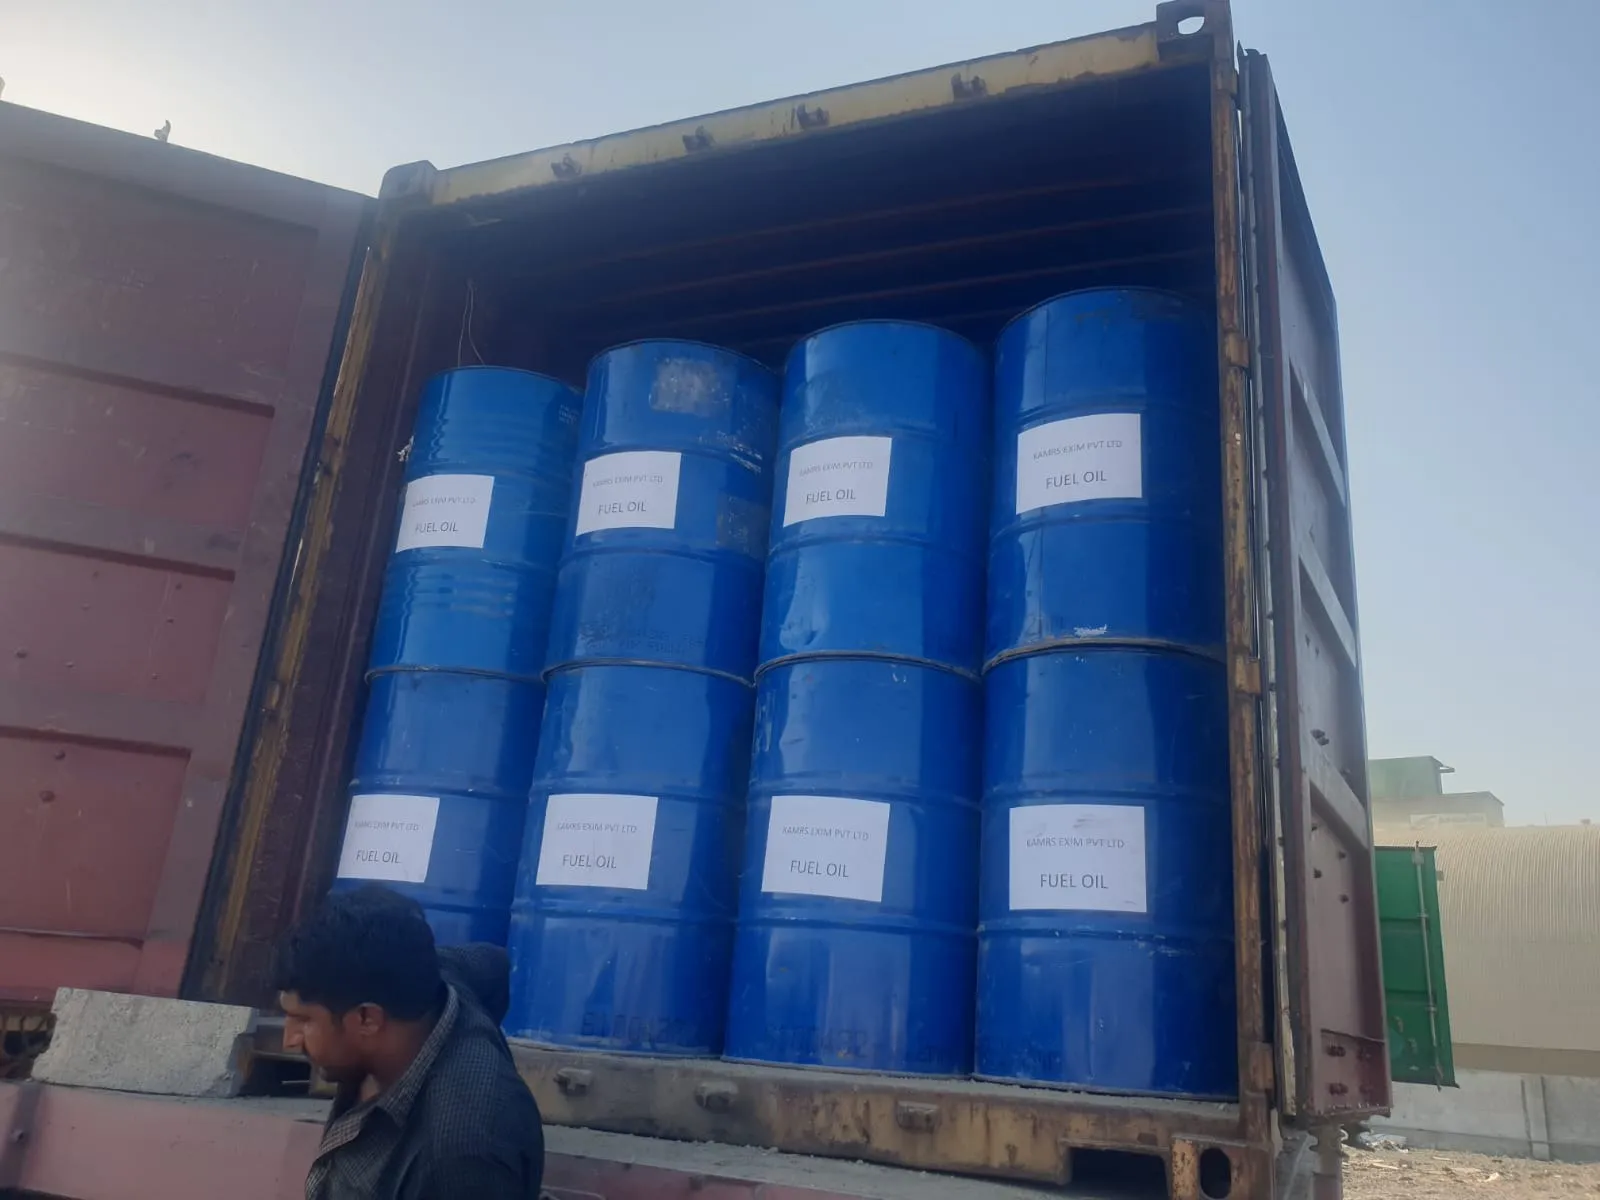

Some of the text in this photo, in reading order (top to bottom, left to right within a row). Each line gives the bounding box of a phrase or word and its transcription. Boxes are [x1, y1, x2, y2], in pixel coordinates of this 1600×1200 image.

[1063, 442, 1086, 455] EXIM
[1087, 440, 1105, 450] PVT
[1107, 440, 1123, 448] LTD
[842, 460, 858, 470] PVT
[859, 461, 873, 470] LTD
[1046, 470, 1108, 489] FUEL OIL
[806, 488, 856, 504] FUEL OIL
[598, 500, 647, 515] FUEL OIL
[415, 521, 459, 533] FUEL OIL
[604, 822, 619, 832] PVT
[621, 823, 638, 833] LTD
[834, 828, 850, 838] PVT
[853, 831, 870, 841] LTD
[1059, 837, 1083, 847] EXIM
[1086, 838, 1104, 847] PVT
[1107, 838, 1125, 849] LTD
[356, 850, 403, 864] FUEL OIL
[562, 854, 617, 869] FUEL OIL
[790, 860, 849, 878] FUEL OIL
[1040, 873, 1109, 889] FUEL OIL
